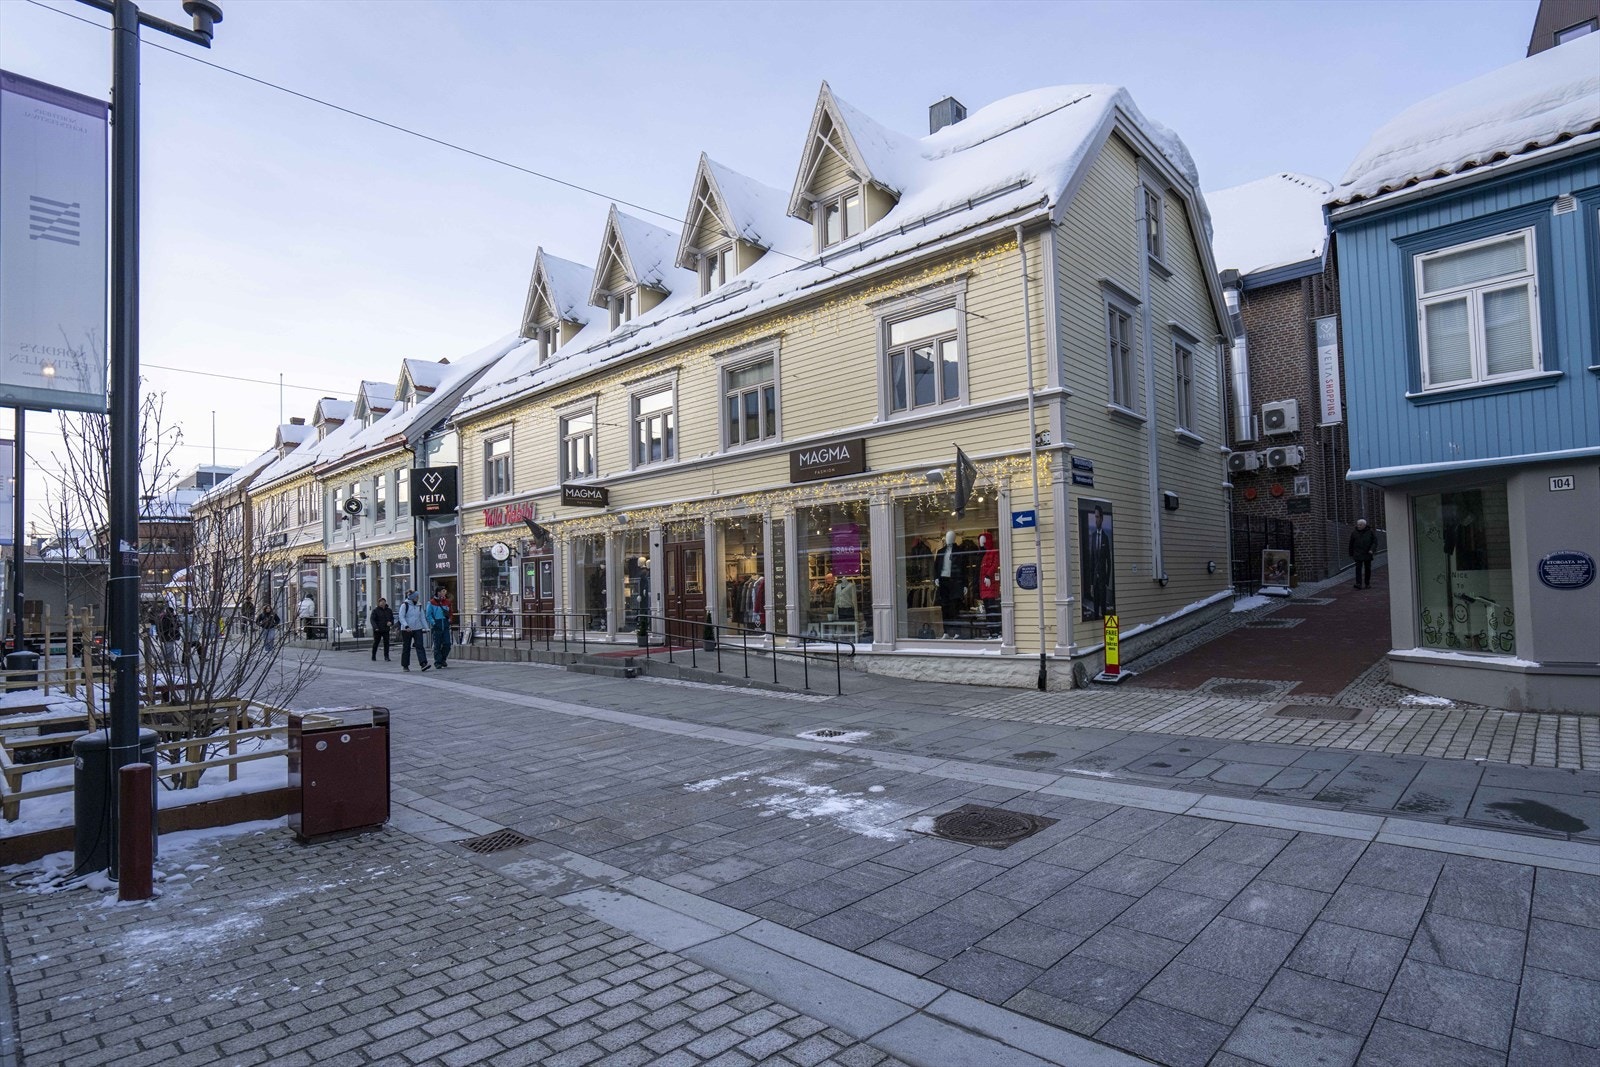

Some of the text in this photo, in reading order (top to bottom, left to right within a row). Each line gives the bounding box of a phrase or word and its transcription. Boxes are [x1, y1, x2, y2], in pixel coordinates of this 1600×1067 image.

[799, 445, 850, 467] MAGMA
[1552, 478, 1571, 489] 104
[419, 493, 446, 503] VEITA
[565, 488, 603, 499] MAGMA
[835, 545, 855, 555] SALG
